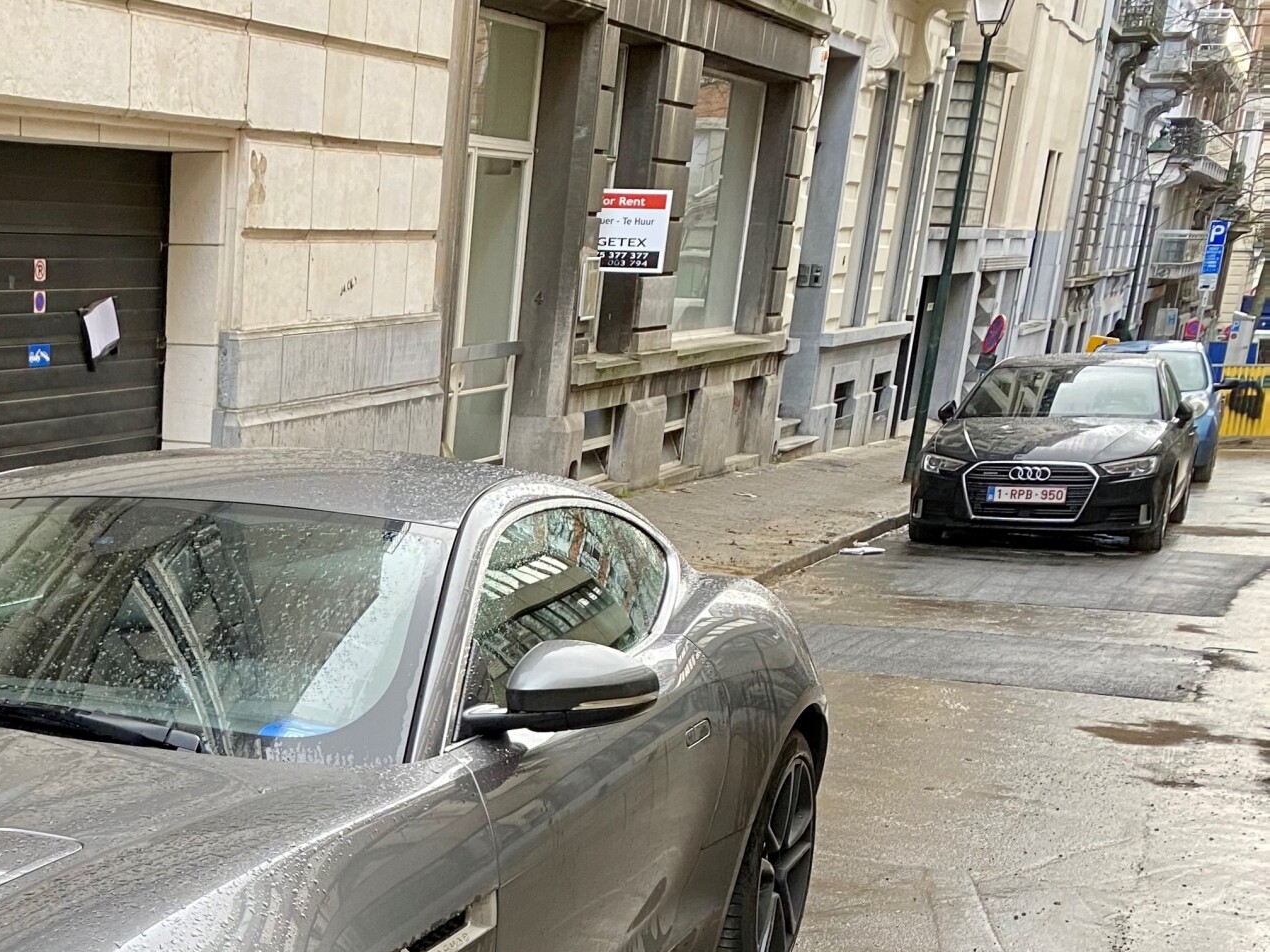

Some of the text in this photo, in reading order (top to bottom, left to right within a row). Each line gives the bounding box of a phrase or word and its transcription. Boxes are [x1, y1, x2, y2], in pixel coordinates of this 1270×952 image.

[618, 196, 646, 207] Rent
[623, 217, 632, 225] Te
[634, 218, 655, 226] Huur
[1210, 224, 1225, 242] P
[598, 237, 647, 247] GETEX
[608, 251, 628, 259] 377
[630, 252, 649, 260] 377
[534, 291, 544, 305] 4
